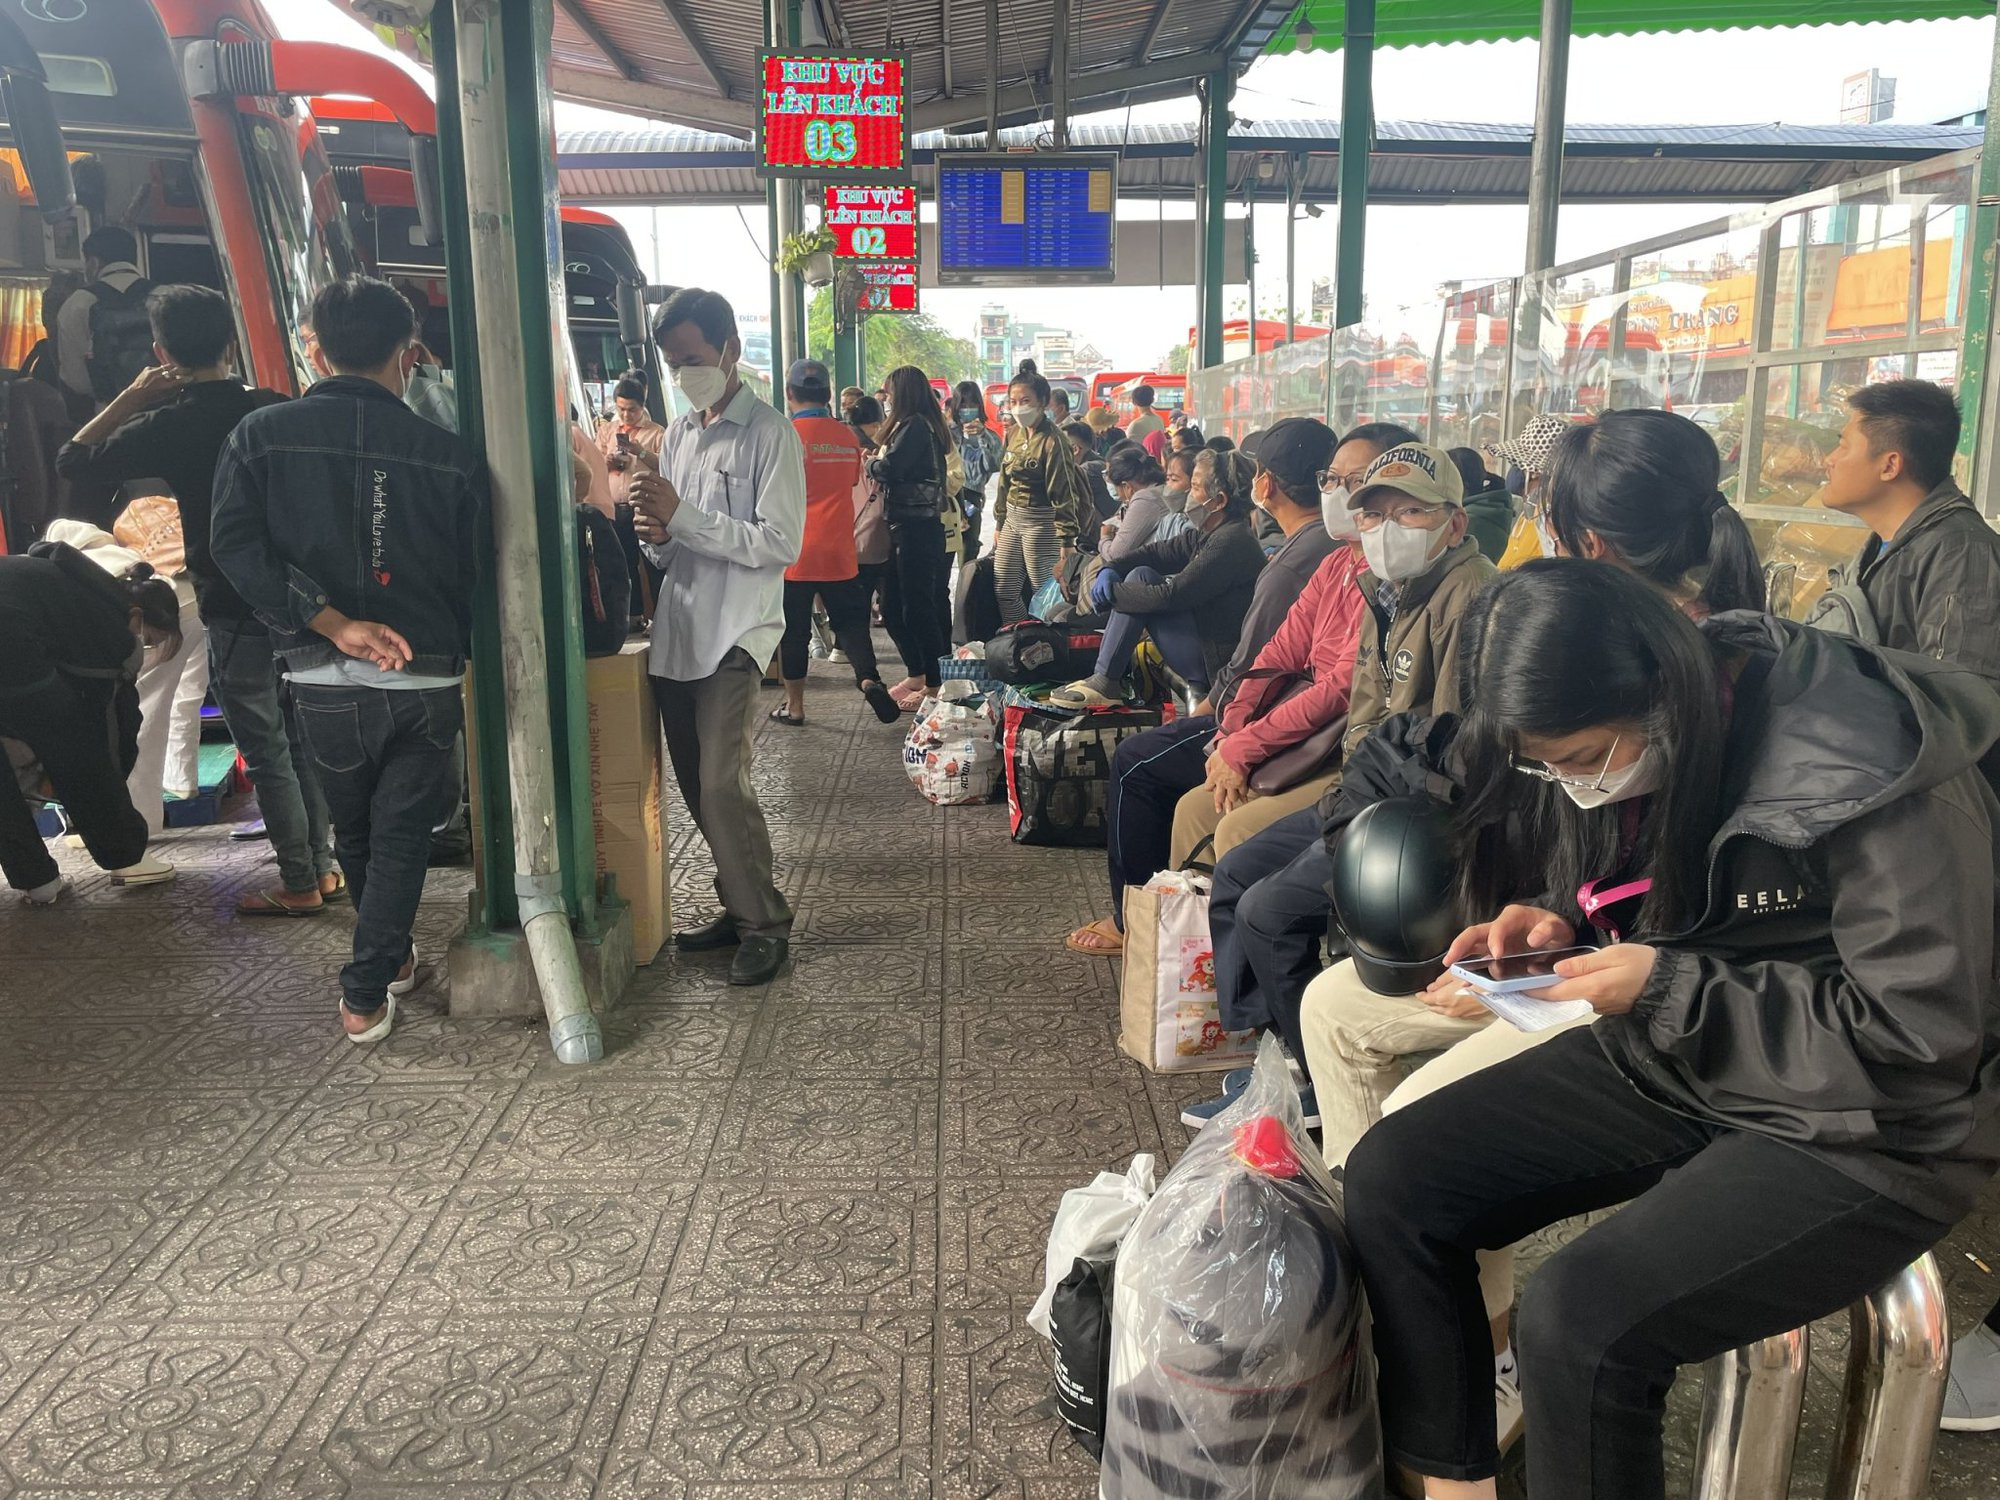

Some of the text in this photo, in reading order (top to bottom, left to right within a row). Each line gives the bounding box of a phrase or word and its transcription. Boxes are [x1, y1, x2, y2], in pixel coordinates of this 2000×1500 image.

[781, 58, 885, 90] KHU VỰC
[767, 86, 898, 116] LÊN KHÁCH
[804, 119, 857, 162] 03
[836, 187, 904, 208] KHU VỰC
[827, 205, 913, 225] LÊN KHÁCH
[851, 226, 887, 255] 02
[373, 470, 387, 483] Do
[1364, 447, 1437, 485] CALIFORNIA
[373, 484, 388, 508] what
[588, 702, 599, 723] TAY
[590, 754, 601, 776] XIN
